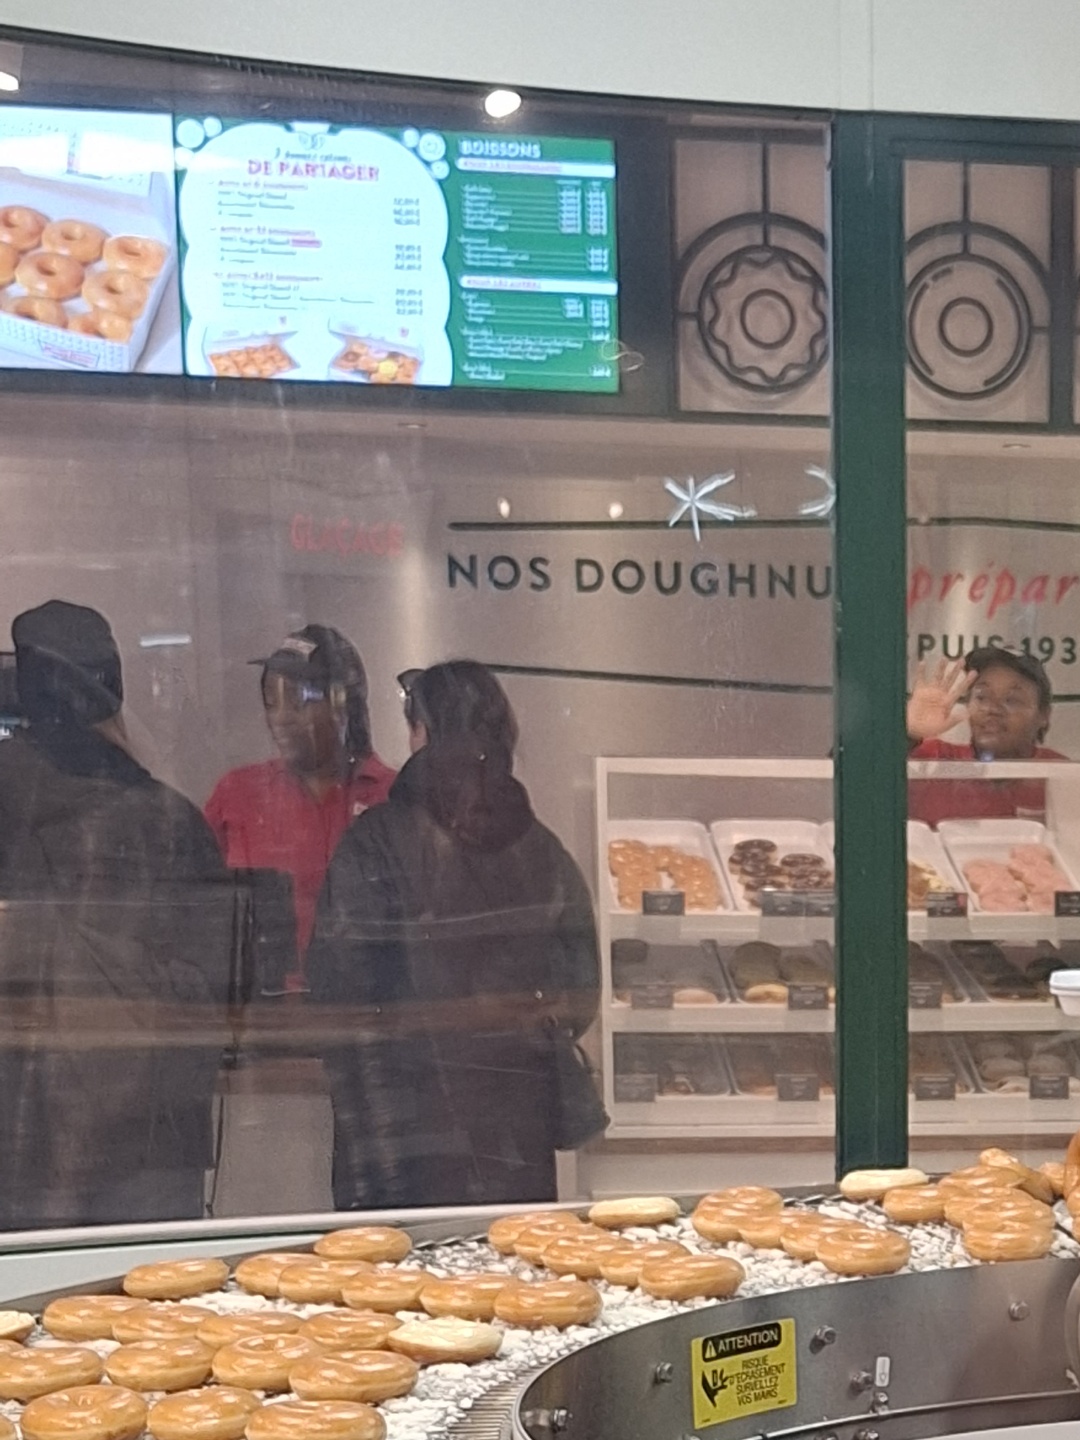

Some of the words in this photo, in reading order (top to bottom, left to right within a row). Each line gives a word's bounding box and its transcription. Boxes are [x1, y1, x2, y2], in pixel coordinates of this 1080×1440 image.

[247, 158, 272, 175] DE
[278, 161, 380, 182] PARTAGER
[447, 554, 552, 592] NOS
[574, 557, 832, 600] DOUGHNU
[917, 634, 1004, 662] PUIS
[718, 1327, 779, 1353] ATTENTION
[741, 1354, 769, 1371] RISQUE
